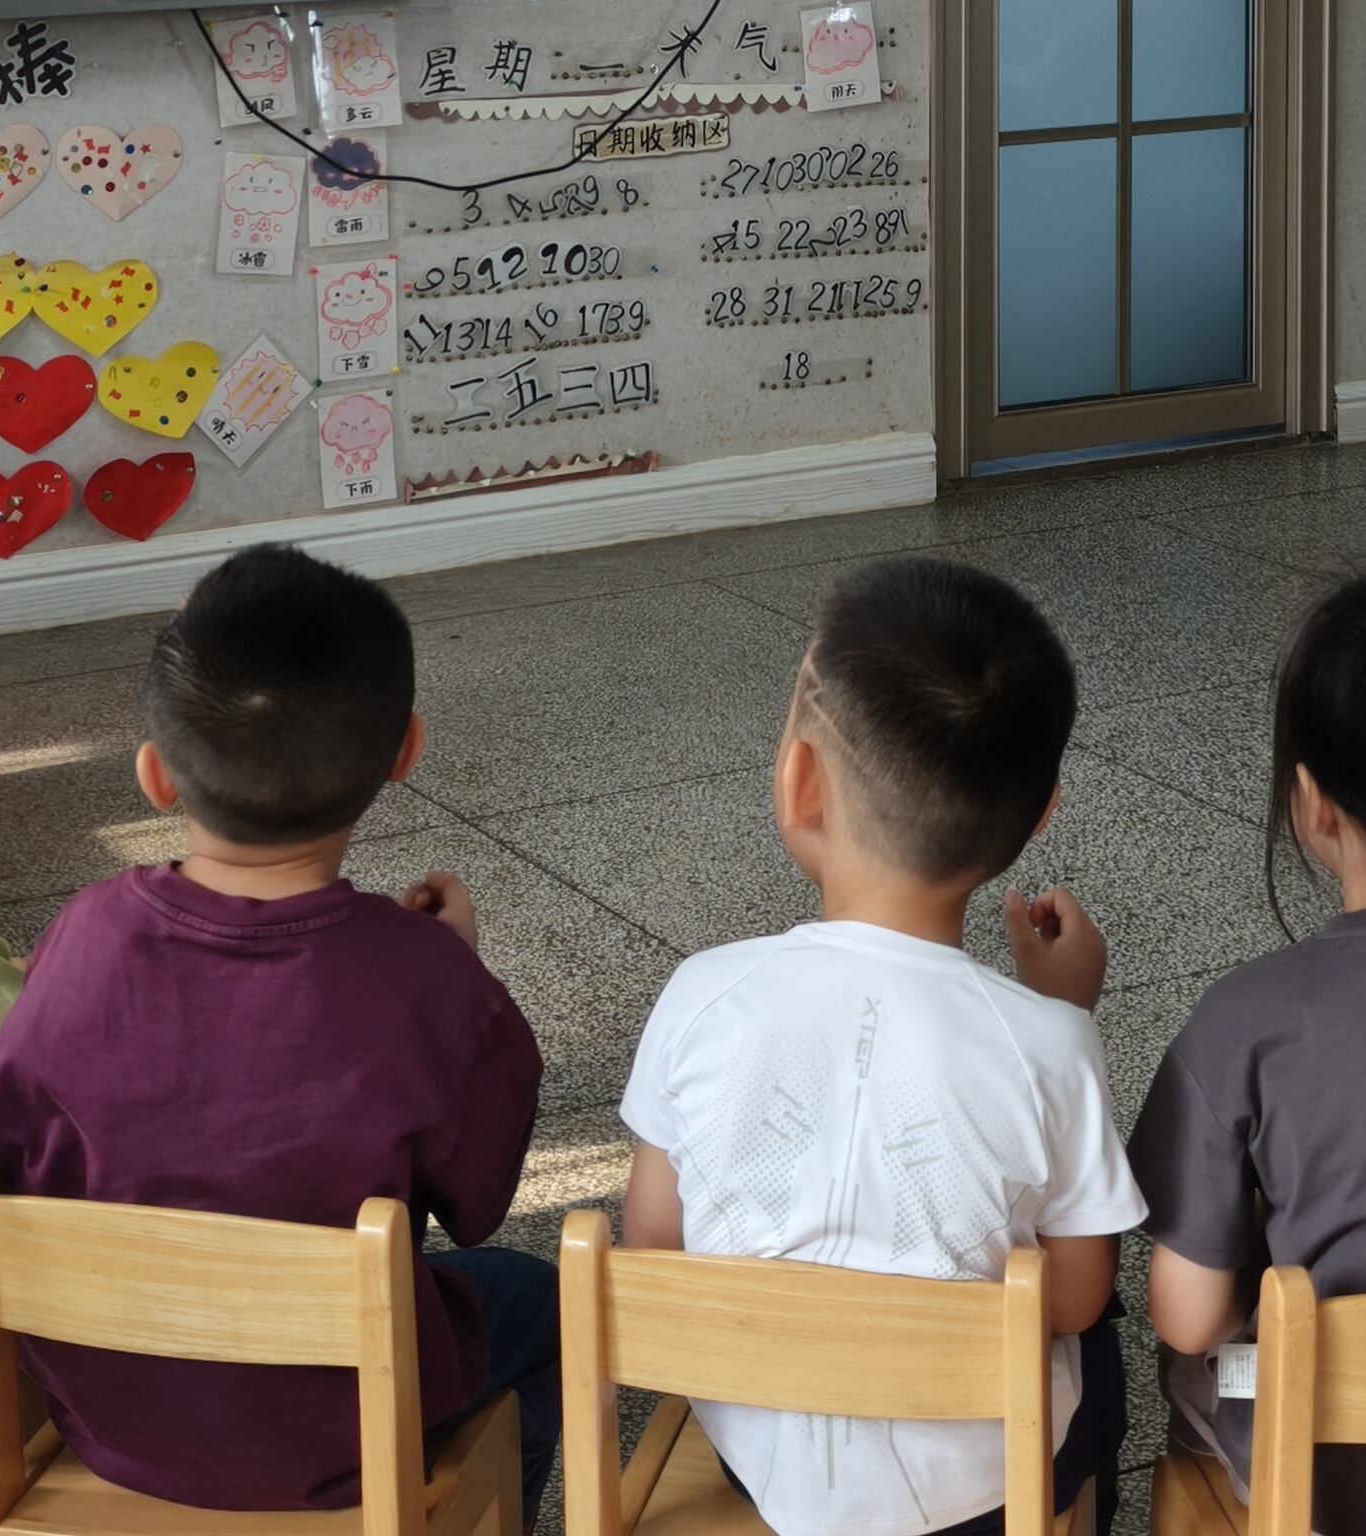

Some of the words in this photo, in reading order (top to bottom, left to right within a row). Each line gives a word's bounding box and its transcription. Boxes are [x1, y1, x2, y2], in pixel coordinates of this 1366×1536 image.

[345, 107, 374, 122] 多云
[577, 117, 727, 157] 日期收纳区
[335, 217, 364, 234] 雷雨
[238, 251, 267, 267] 冰雹
[341, 354, 371, 371] 下雪
[783, 351, 810, 380] 18
[211, 416, 238, 445] 晴天
[346, 480, 374, 496] 下雨
[855, 995, 882, 1079] XTEP
